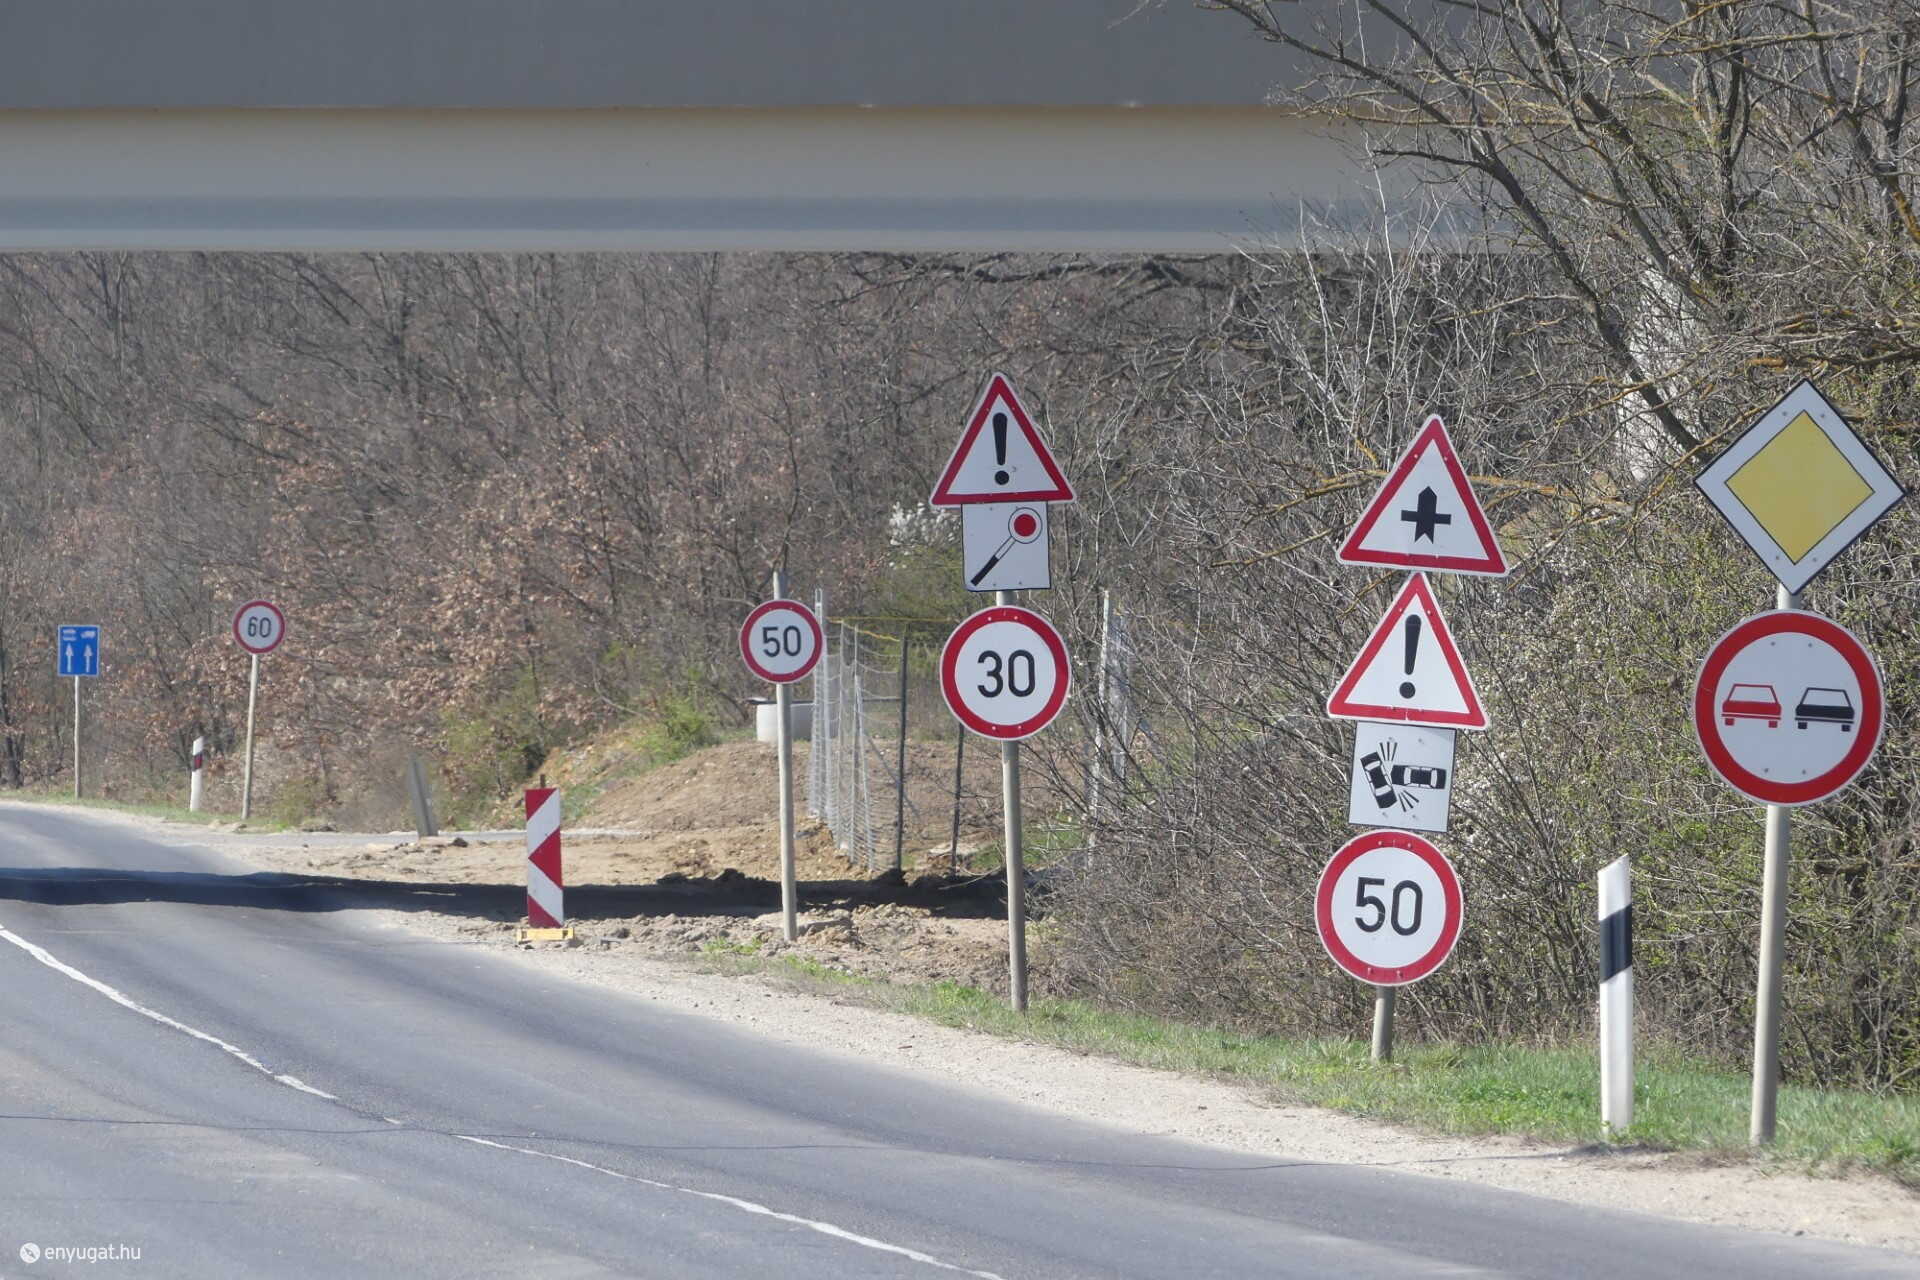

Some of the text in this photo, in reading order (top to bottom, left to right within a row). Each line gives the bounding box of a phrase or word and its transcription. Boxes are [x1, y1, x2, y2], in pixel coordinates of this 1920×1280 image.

[247, 616, 272, 638] 60
[762, 625, 802, 658] 50
[977, 649, 1036, 699] 30
[1354, 876, 1424, 937] 50
